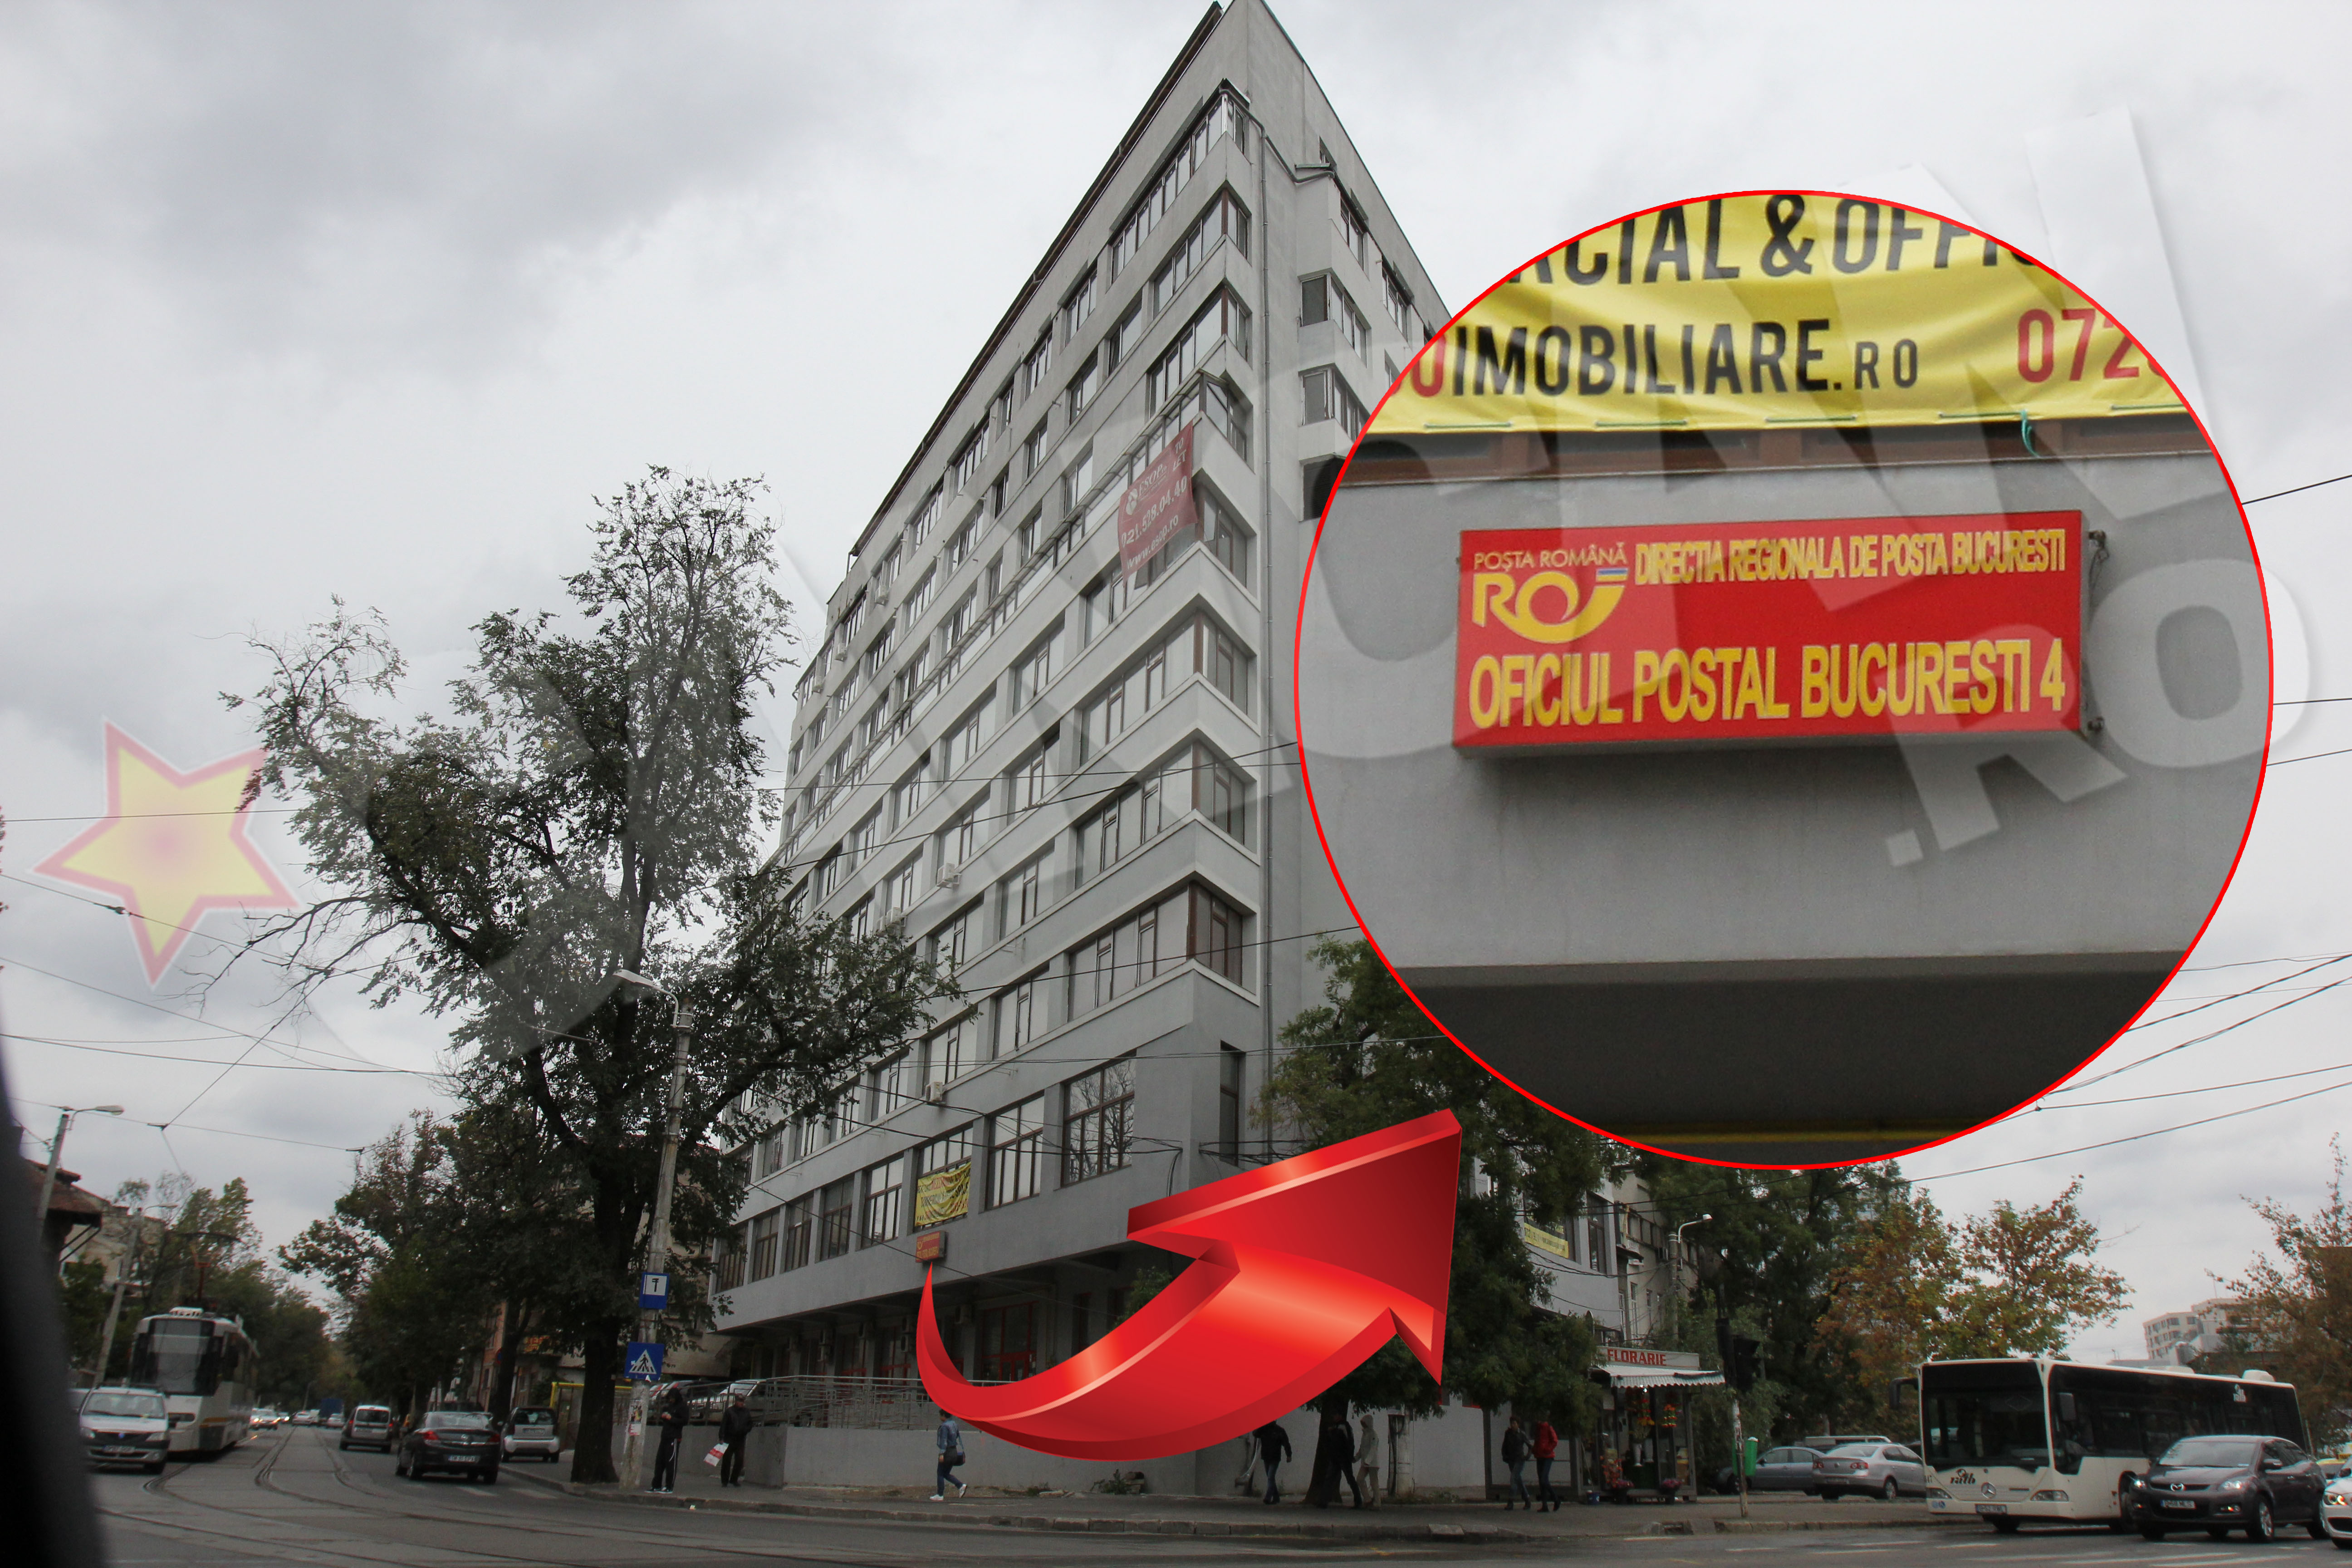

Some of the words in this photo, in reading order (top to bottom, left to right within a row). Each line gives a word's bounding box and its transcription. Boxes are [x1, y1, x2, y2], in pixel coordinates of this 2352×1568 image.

[1509, 198, 1740, 285] CIAL
[1760, 194, 1815, 277] &
[2017, 308, 2163, 383] 072
[1172, 449, 1187, 472] LET
[1127, 515, 1179, 570] www.esop.ro
[1540, 542, 1628, 568] ROMÂNĂ
[1635, 540, 1724, 585] DIRECTIA
[1728, 536, 1845, 583] REGIONALA
[1849, 535, 1878, 578] DE
[1882, 532, 1948, 577] POSTA
[1952, 528, 2066, 574] BUCURESTI
[1470, 652, 1624, 729] OFICIUL
[1632, 647, 1790, 723] POSTAL
[1801, 639, 2031, 718] BUCURESTI
[2039, 638, 2065, 712] 4
[1607, 1349, 1666, 1366] FLORARIE
